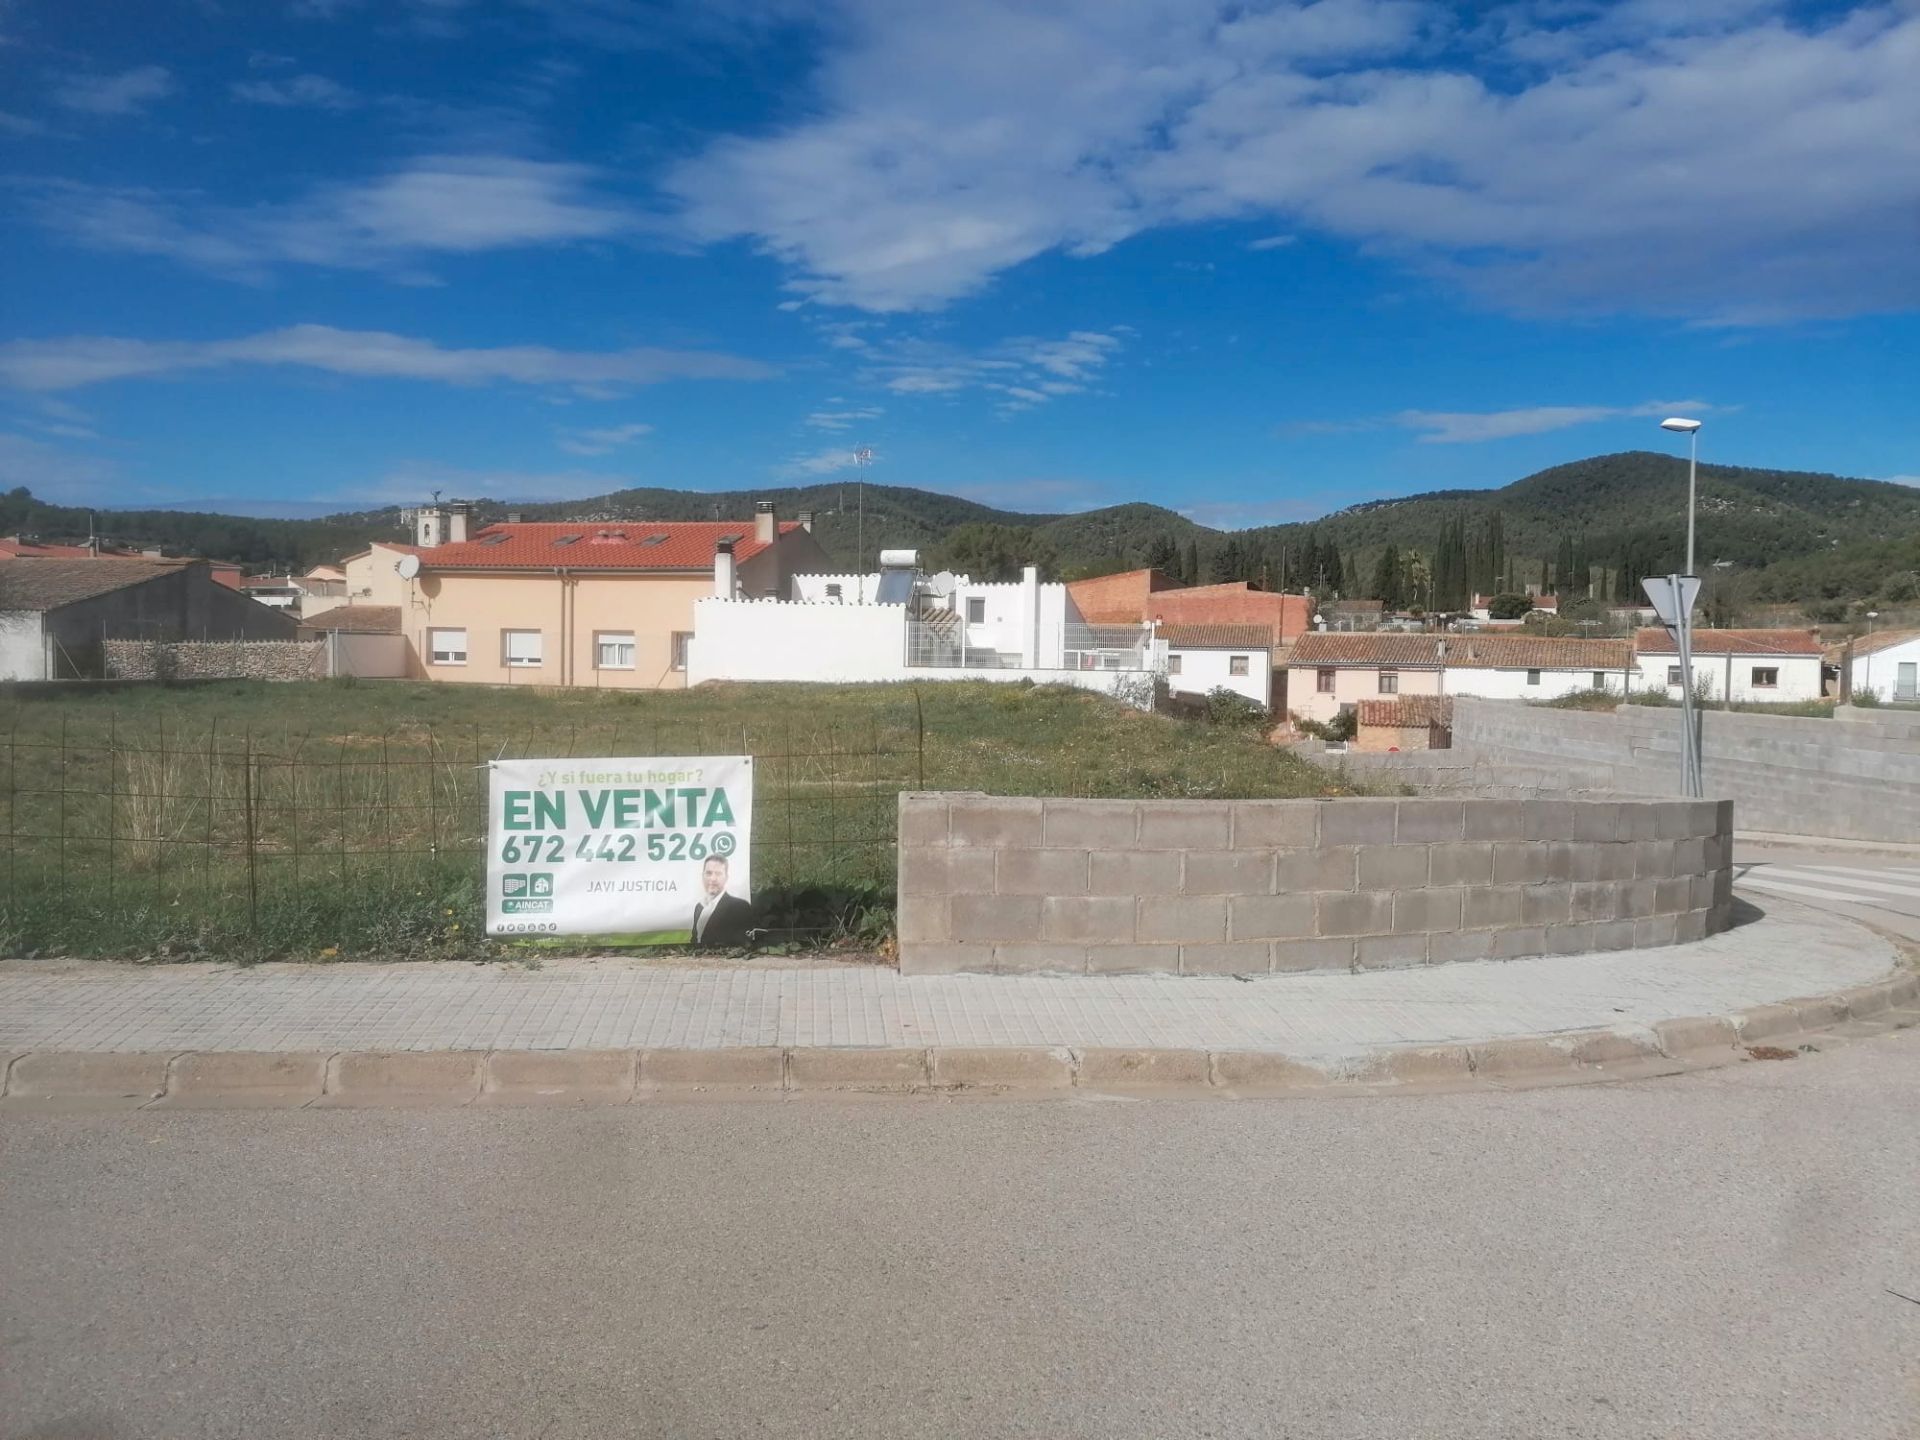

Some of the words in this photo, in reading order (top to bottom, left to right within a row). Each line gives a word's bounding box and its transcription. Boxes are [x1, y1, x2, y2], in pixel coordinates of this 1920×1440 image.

[537, 772, 557, 788] ¿Y
[562, 771, 576, 785] si
[580, 771, 622, 784] fuera
[626, 771, 643, 784] tu
[648, 769, 703, 786] hogar?
[504, 791, 566, 830] EN
[578, 787, 736, 829] VENTA
[502, 835, 564, 863] 672
[576, 834, 636, 862] 442
[647, 833, 706, 862] 526
[586, 881, 615, 893] JAVI
[619, 880, 677, 892] JUSTICIA
